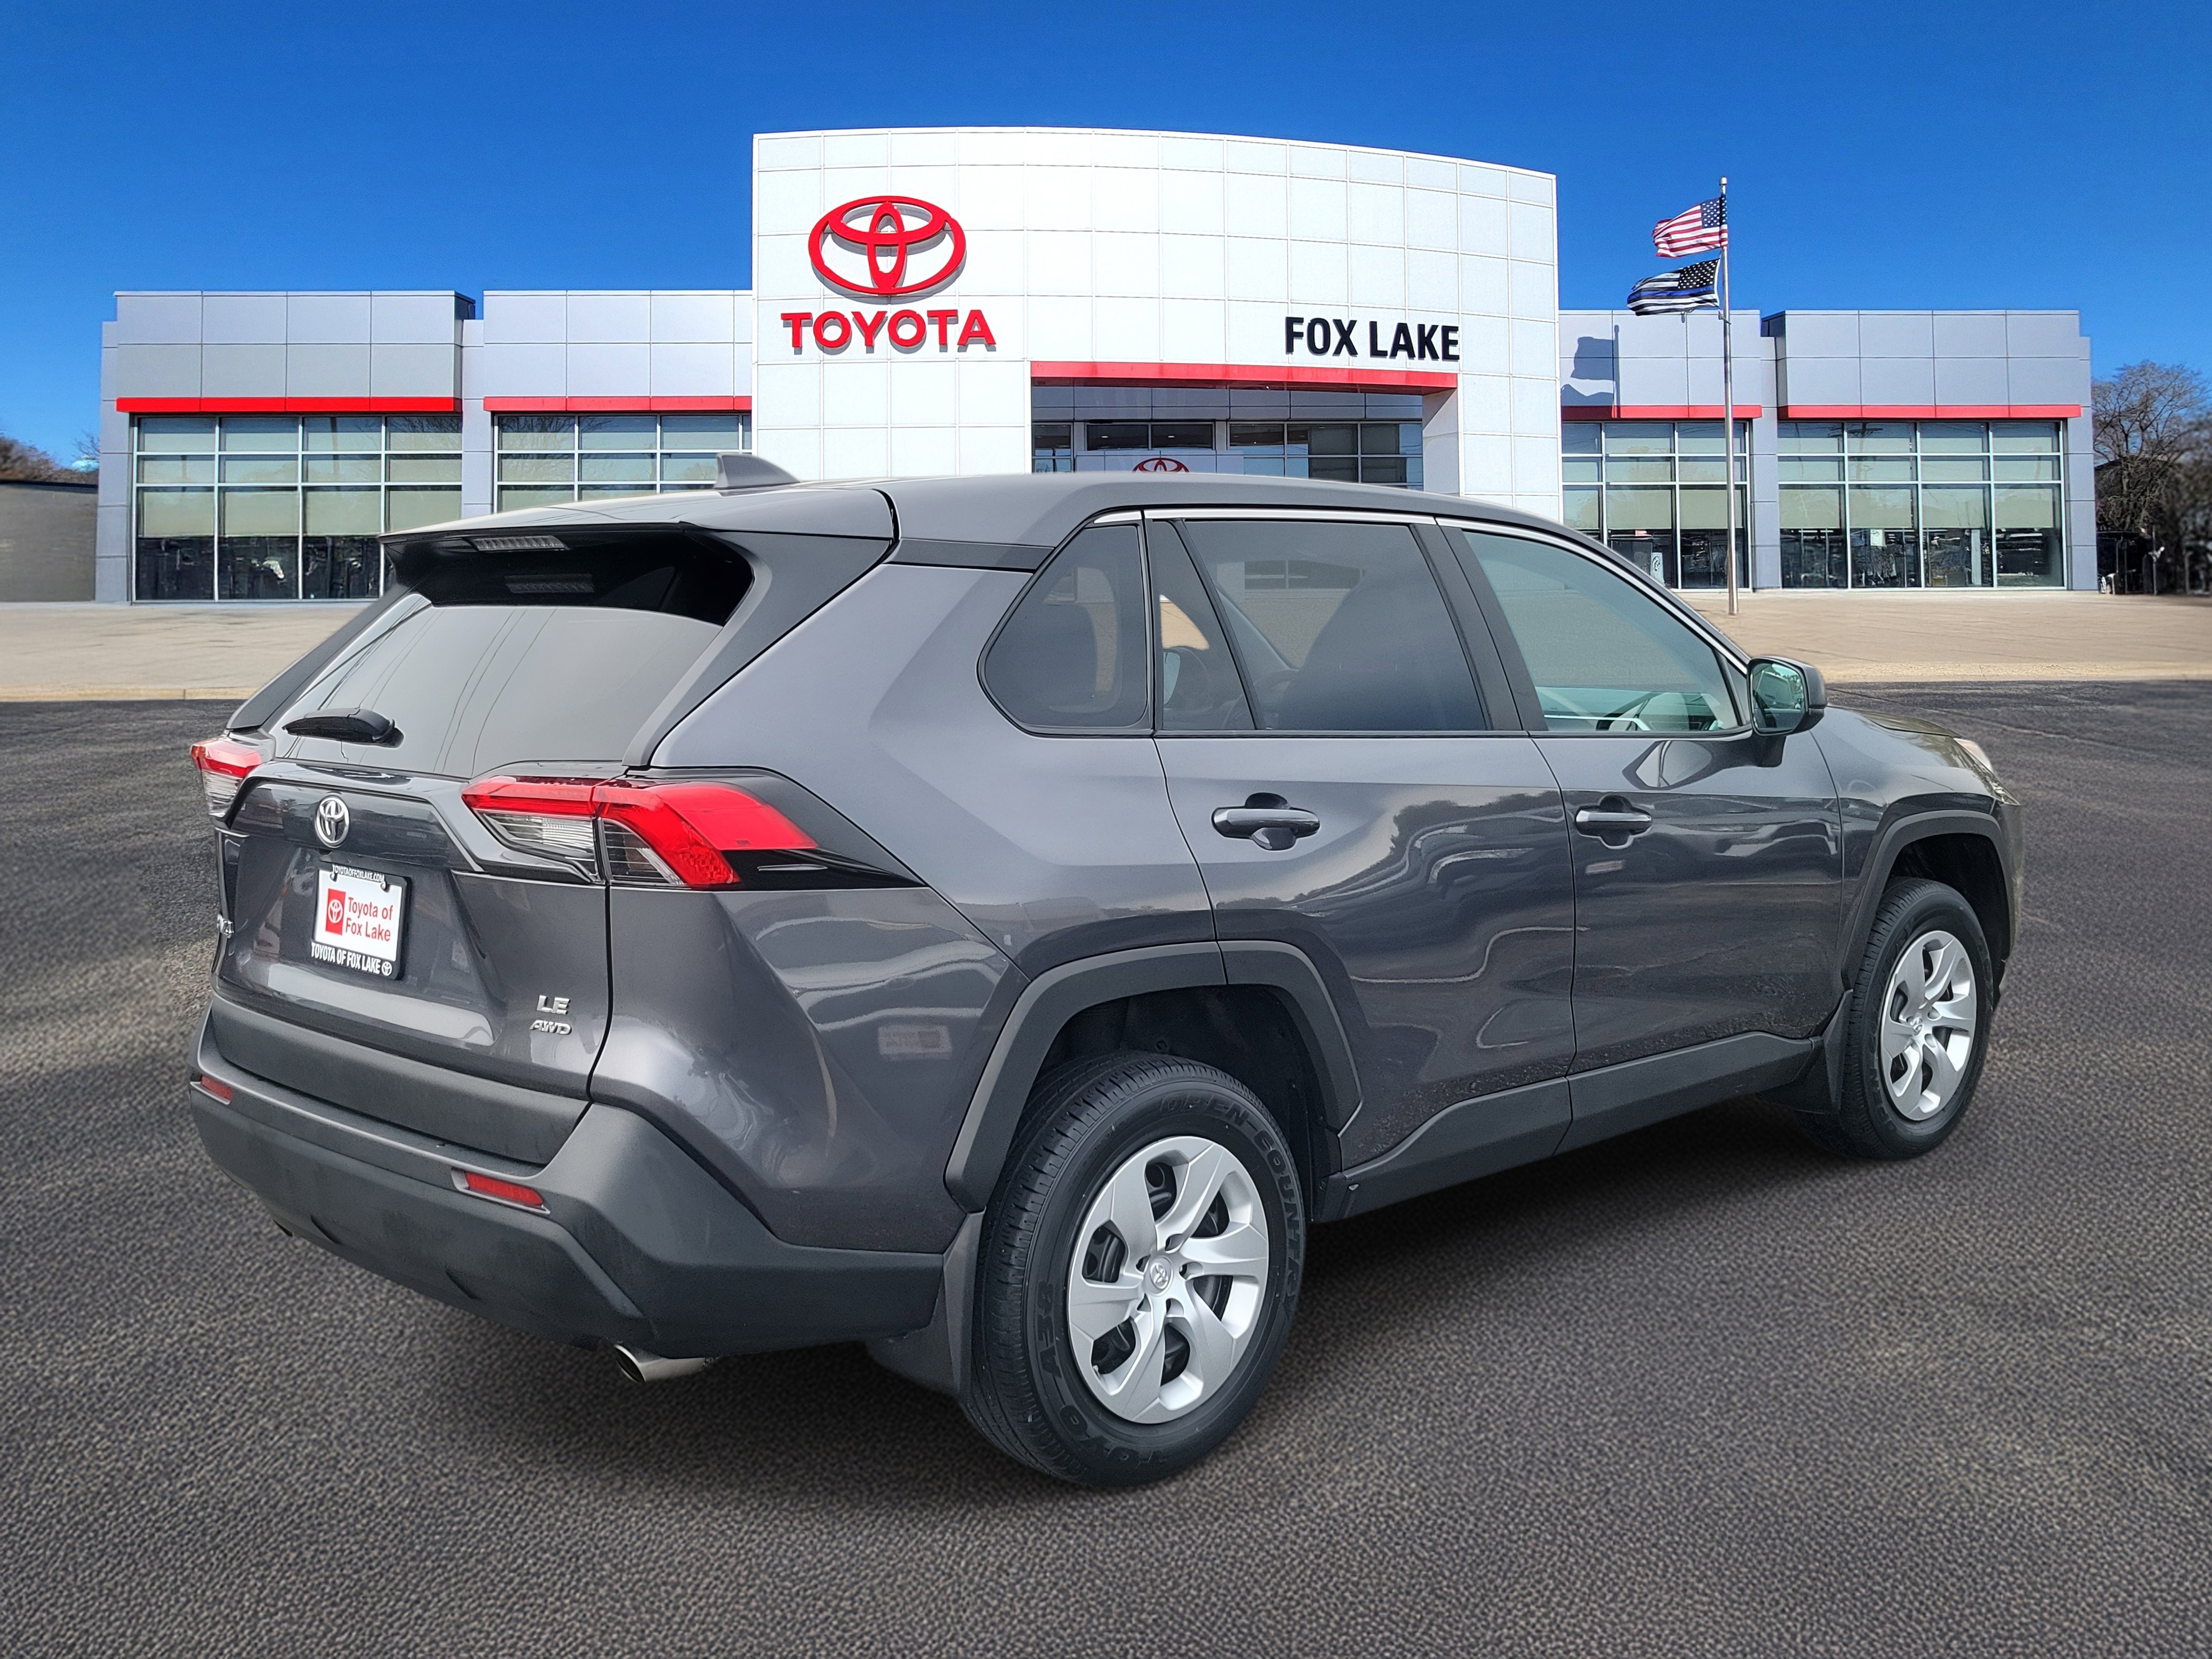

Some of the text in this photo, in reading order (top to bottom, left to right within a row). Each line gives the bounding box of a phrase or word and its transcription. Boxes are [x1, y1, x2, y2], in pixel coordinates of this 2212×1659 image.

[781, 309, 997, 350] TOYOTA
[1285, 316, 1459, 361] FOX LAKE
[332, 864, 385, 882] TOYOTAOFFOXLAKE.COM
[348, 897, 393, 920] Toyota of
[346, 918, 391, 942] Fox Lake
[311, 943, 381, 974] TOYOTA OF FOX LAKE
[537, 995, 570, 1015] LE
[529, 1020, 572, 1035] AWD
